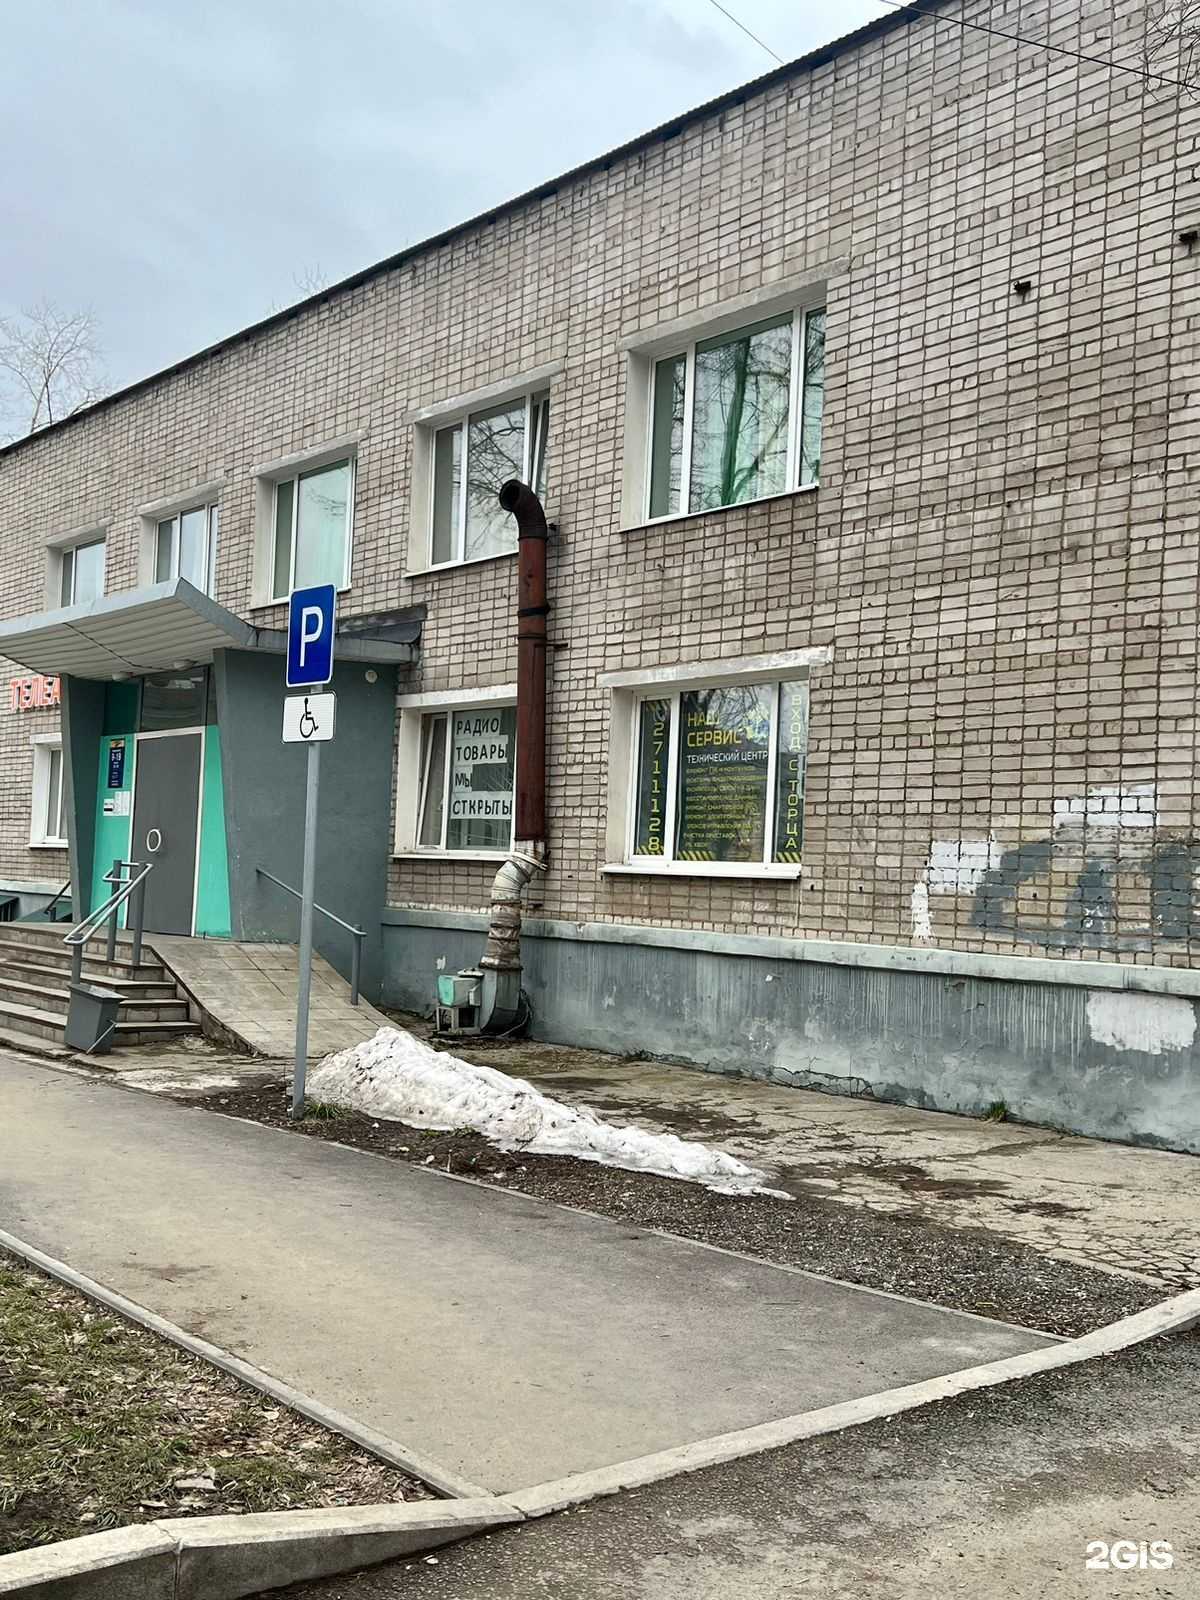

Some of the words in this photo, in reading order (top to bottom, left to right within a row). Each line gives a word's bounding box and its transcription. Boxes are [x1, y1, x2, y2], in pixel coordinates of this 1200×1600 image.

[300, 606, 324, 667] P
[456, 718, 500, 737] РАДИО
[687, 711, 720, 727] НАШ
[790, 695, 801, 750] ВХОД
[687, 729, 742, 747] СЕРВИС
[456, 744, 508, 761] ТОВАРЫ
[687, 750, 739, 764] ТЕХНИЧЕСКИЙ
[741, 750, 769, 762] ЦЕНТР
[455, 773, 472, 788] МЫ
[648, 722, 664, 850] 2711128
[786, 780, 799, 849] ТОРЦА
